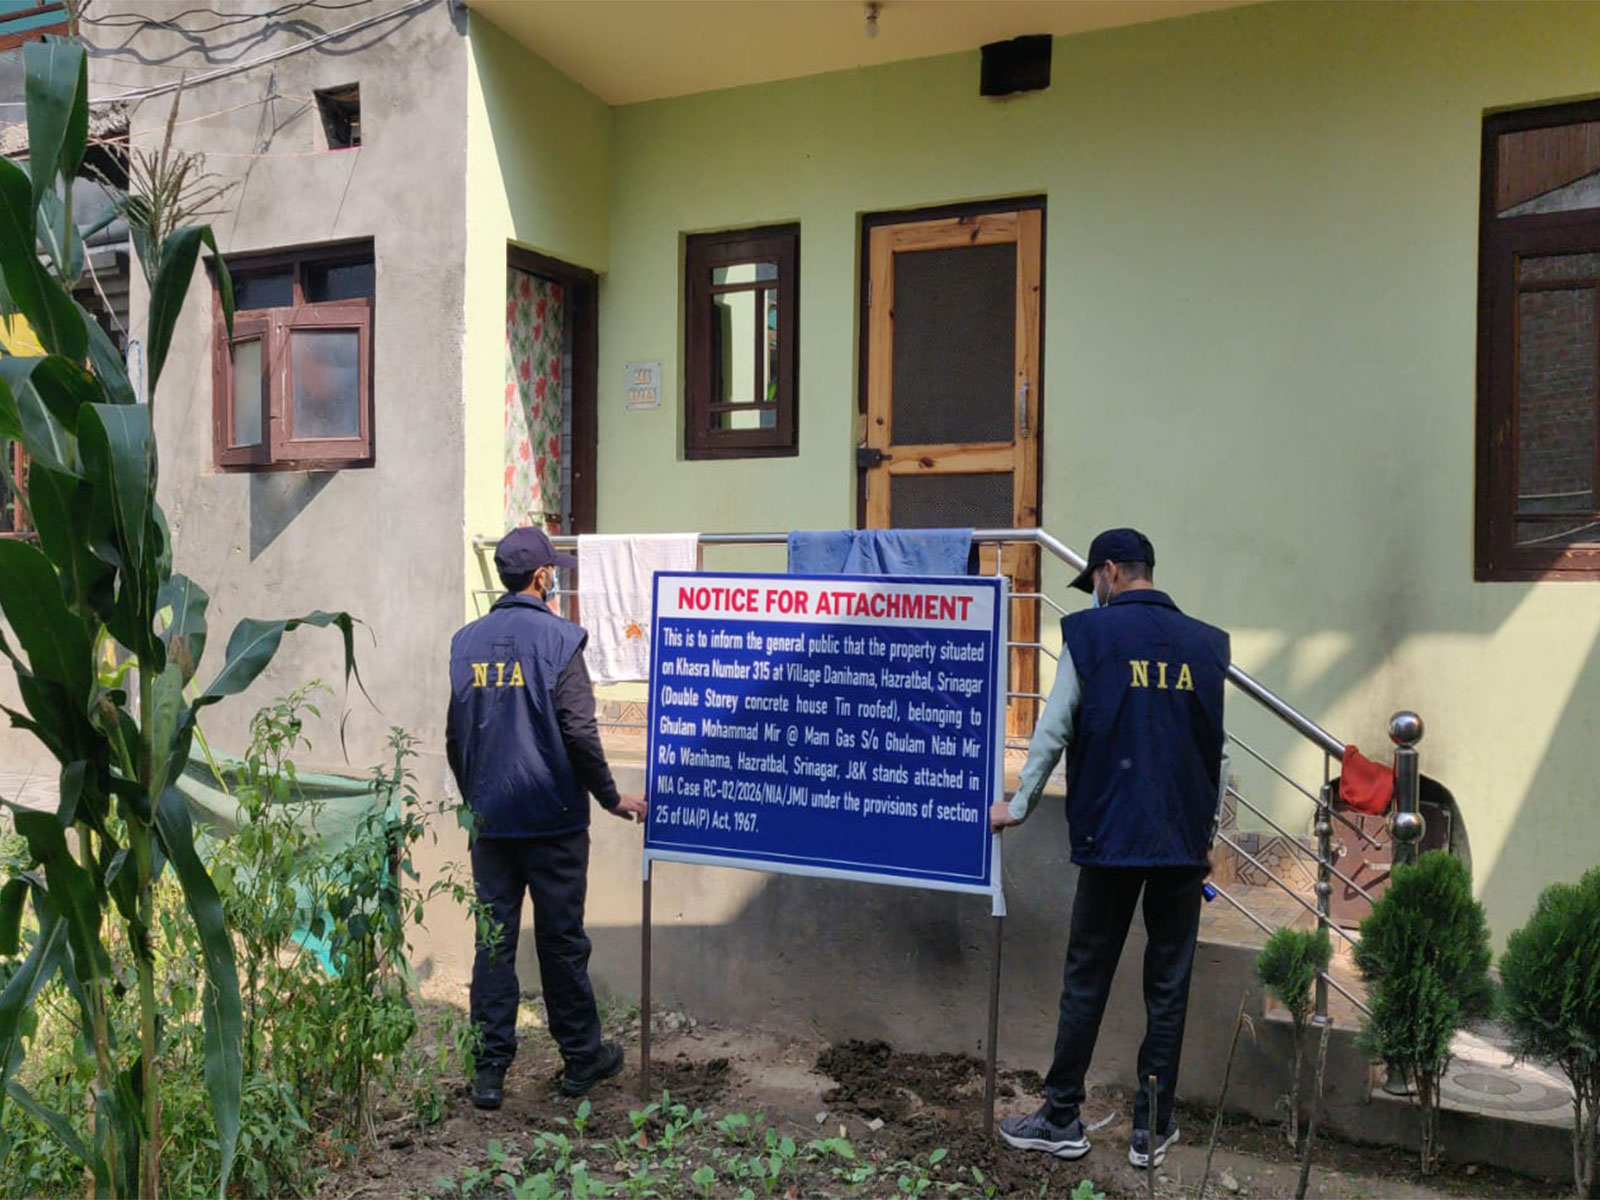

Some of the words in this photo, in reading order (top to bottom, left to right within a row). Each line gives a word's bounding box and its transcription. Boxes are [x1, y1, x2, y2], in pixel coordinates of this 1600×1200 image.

[678, 587, 759, 612] NOTICE
[766, 590, 808, 614] FOR
[816, 592, 973, 620] ATTACHMENT
[663, 628, 682, 647] This
[686, 629, 694, 647] is
[698, 630, 707, 648] to
[711, 630, 743, 649] inform
[747, 632, 762, 650] the
[767, 633, 804, 655] general
[809, 634, 840, 656] public
[844, 635, 865, 655] that
[869, 636, 886, 656] the
[890, 642, 936, 664] property
[940, 641, 984, 661] situated
[471, 661, 526, 687] NIA
[662, 662, 674, 675] on
[676, 657, 710, 677] Khasra
[712, 659, 750, 679] Number
[753, 661, 769, 680] 315
[773, 663, 783, 681] at
[786, 664, 821, 687] Village
[824, 666, 878, 689] Danihama,
[938, 672, 984, 698] Srinagar
[1129, 660, 1194, 691] NIA
[661, 686, 698, 707] (Double
[705, 689, 738, 713] Storey
[745, 695, 789, 712] concrete
[797, 695, 828, 714] house
[835, 697, 851, 716] Tin
[858, 699, 901, 722] roofed),
[908, 702, 962, 729] belonging
[970, 707, 981, 726] to
[660, 716, 696, 736] Ghulam
[702, 718, 758, 740] Mohammad
[764, 723, 781, 742] Mir
[787, 726, 798, 746] @
[805, 726, 829, 746] Mam
[836, 728, 855, 747] Gas
[886, 731, 925, 754] Ghulam
[932, 735, 956, 755] Nabi
[963, 738, 981, 758] Mir
[659, 745, 675, 765] R/o
[680, 747, 732, 770] Wanihama,
[794, 756, 840, 782] Srinagar,
[846, 761, 867, 780] J&K
[872, 764, 909, 784] stands
[914, 769, 963, 789] attached
[969, 772, 979, 790] in
[658, 776, 674, 794] NIA
[677, 777, 700, 796] Case
[812, 788, 840, 809] under
[844, 791, 860, 809] the
[863, 794, 918, 817] provisions
[922, 799, 933, 818] of
[937, 803, 978, 823] section
[656, 805, 668, 823] 25
[671, 808, 681, 824] of
[683, 808, 709, 830] UA(P)
[712, 811, 731, 831] Act,
[734, 813, 759, 833] 1967.
